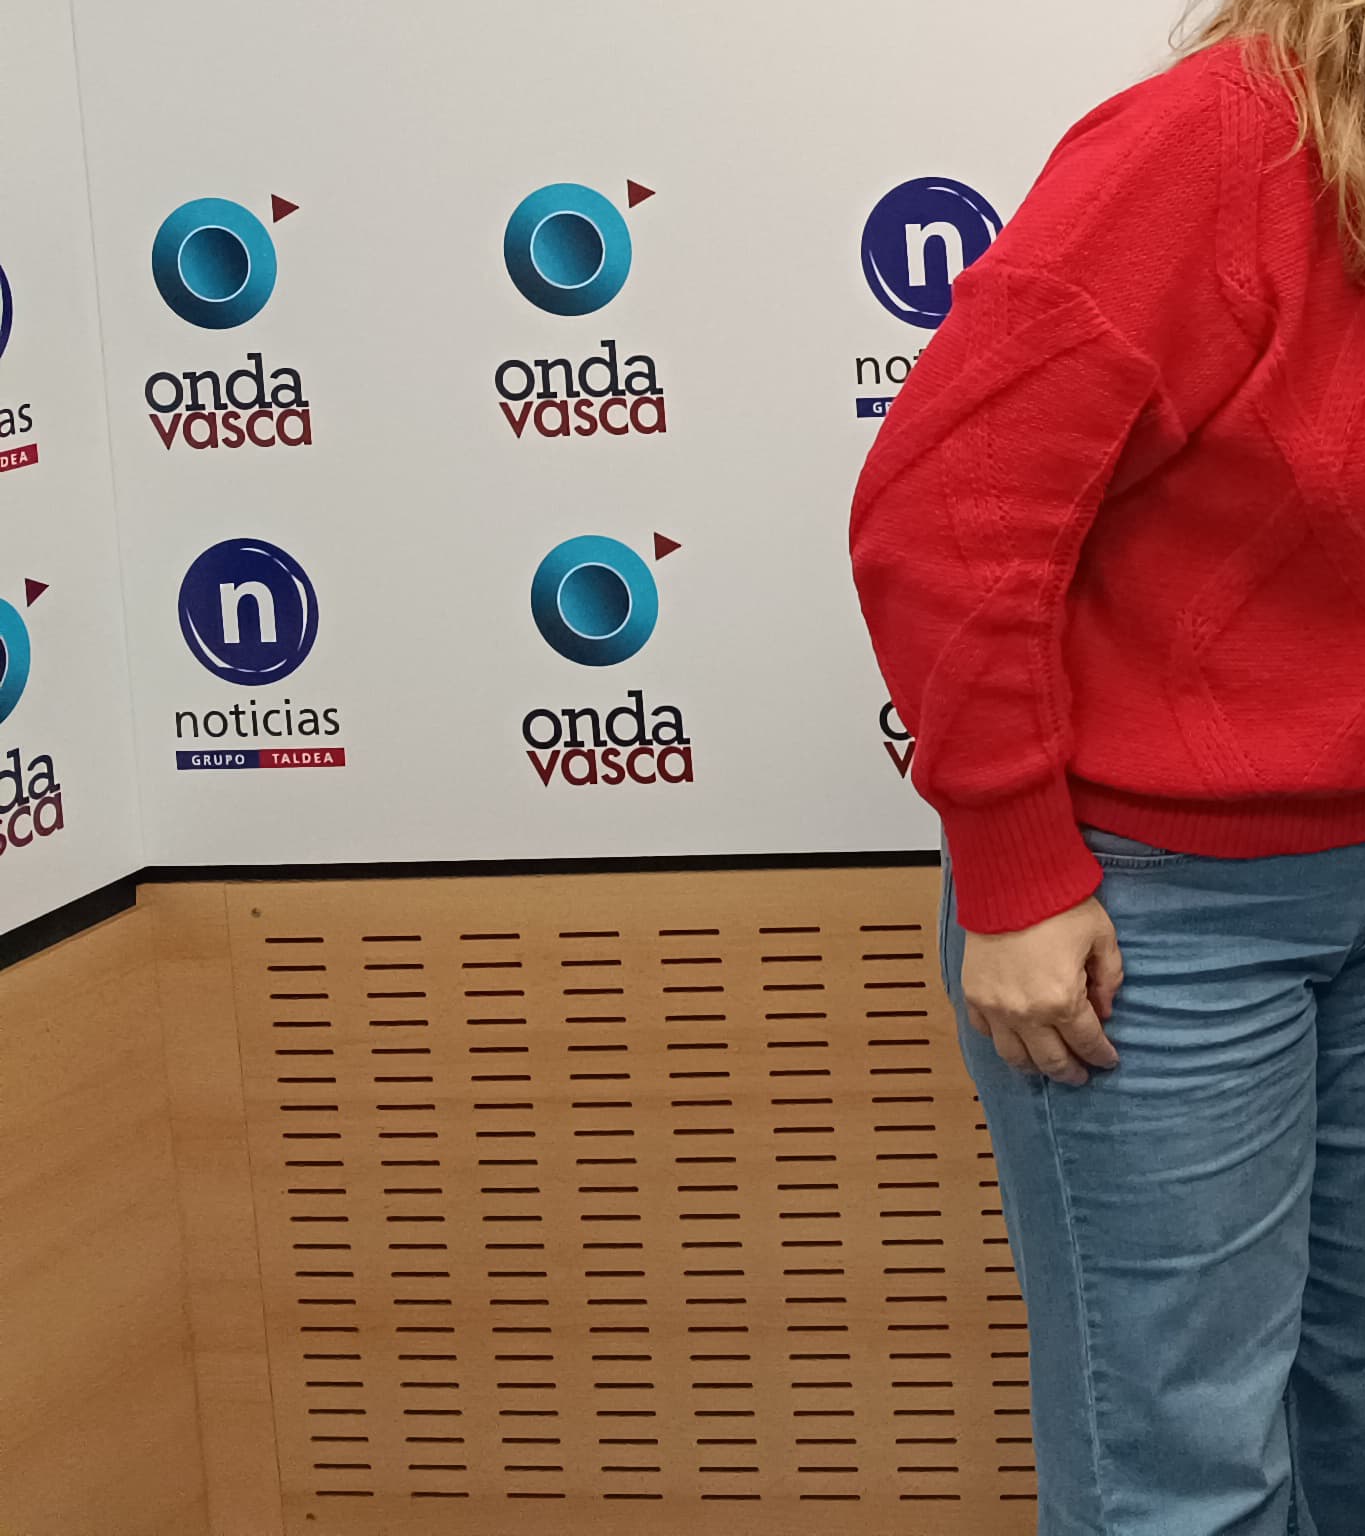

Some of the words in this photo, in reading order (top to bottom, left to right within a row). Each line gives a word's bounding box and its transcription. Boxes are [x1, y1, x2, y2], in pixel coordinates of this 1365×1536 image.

[144, 352, 310, 414] onda
[494, 340, 664, 402] onda
[149, 408, 314, 450] vasca
[500, 395, 667, 438] vasca
[174, 698, 341, 739] noticias
[522, 690, 691, 751] onda
[190, 753, 247, 766] GRUPO
[271, 751, 335, 765] TALDEA
[527, 745, 695, 786] vasca
